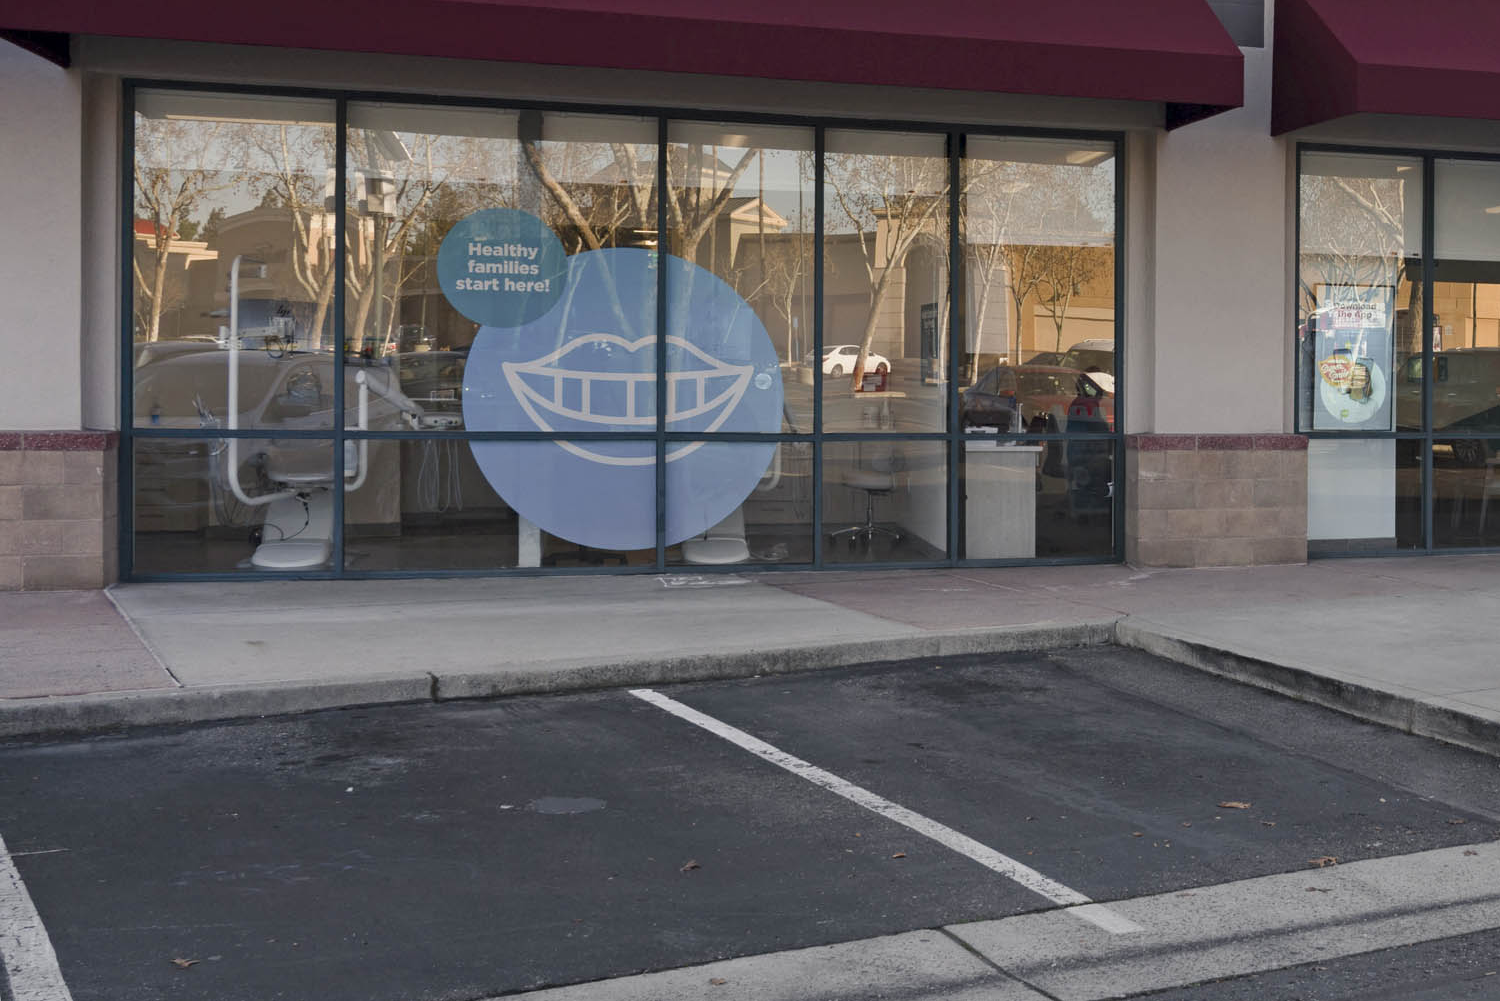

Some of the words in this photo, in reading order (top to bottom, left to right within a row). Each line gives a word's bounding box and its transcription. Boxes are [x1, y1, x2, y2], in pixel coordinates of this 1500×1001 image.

[467, 242, 539, 260] Healthy
[467, 259, 540, 275] families
[455, 277, 500, 291] start
[504, 277, 550, 292] here!
